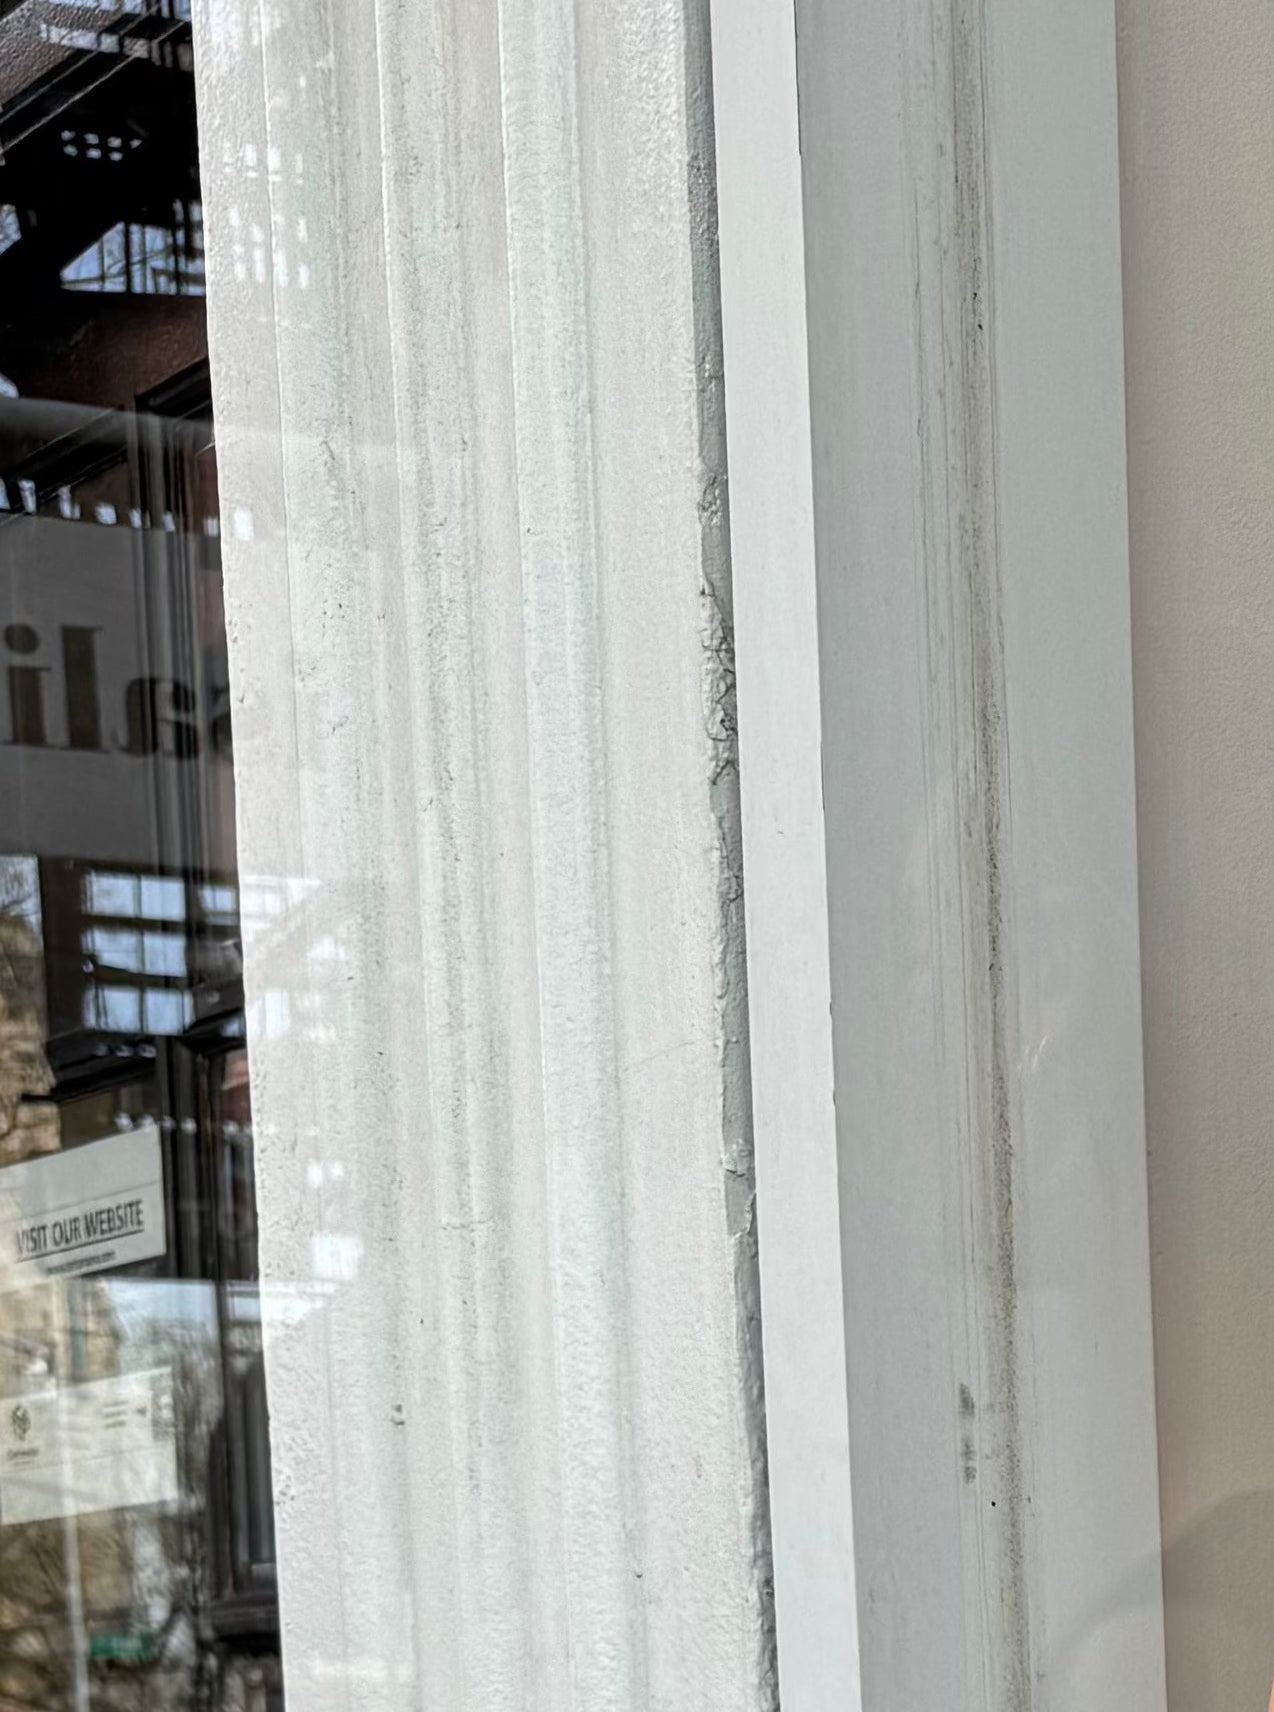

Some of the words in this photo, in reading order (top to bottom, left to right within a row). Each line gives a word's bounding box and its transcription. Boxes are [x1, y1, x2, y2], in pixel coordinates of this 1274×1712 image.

[15, 1224, 49, 1256] VISIT
[52, 1216, 81, 1247] OUR
[84, 1199, 144, 1238] WEBSITE
